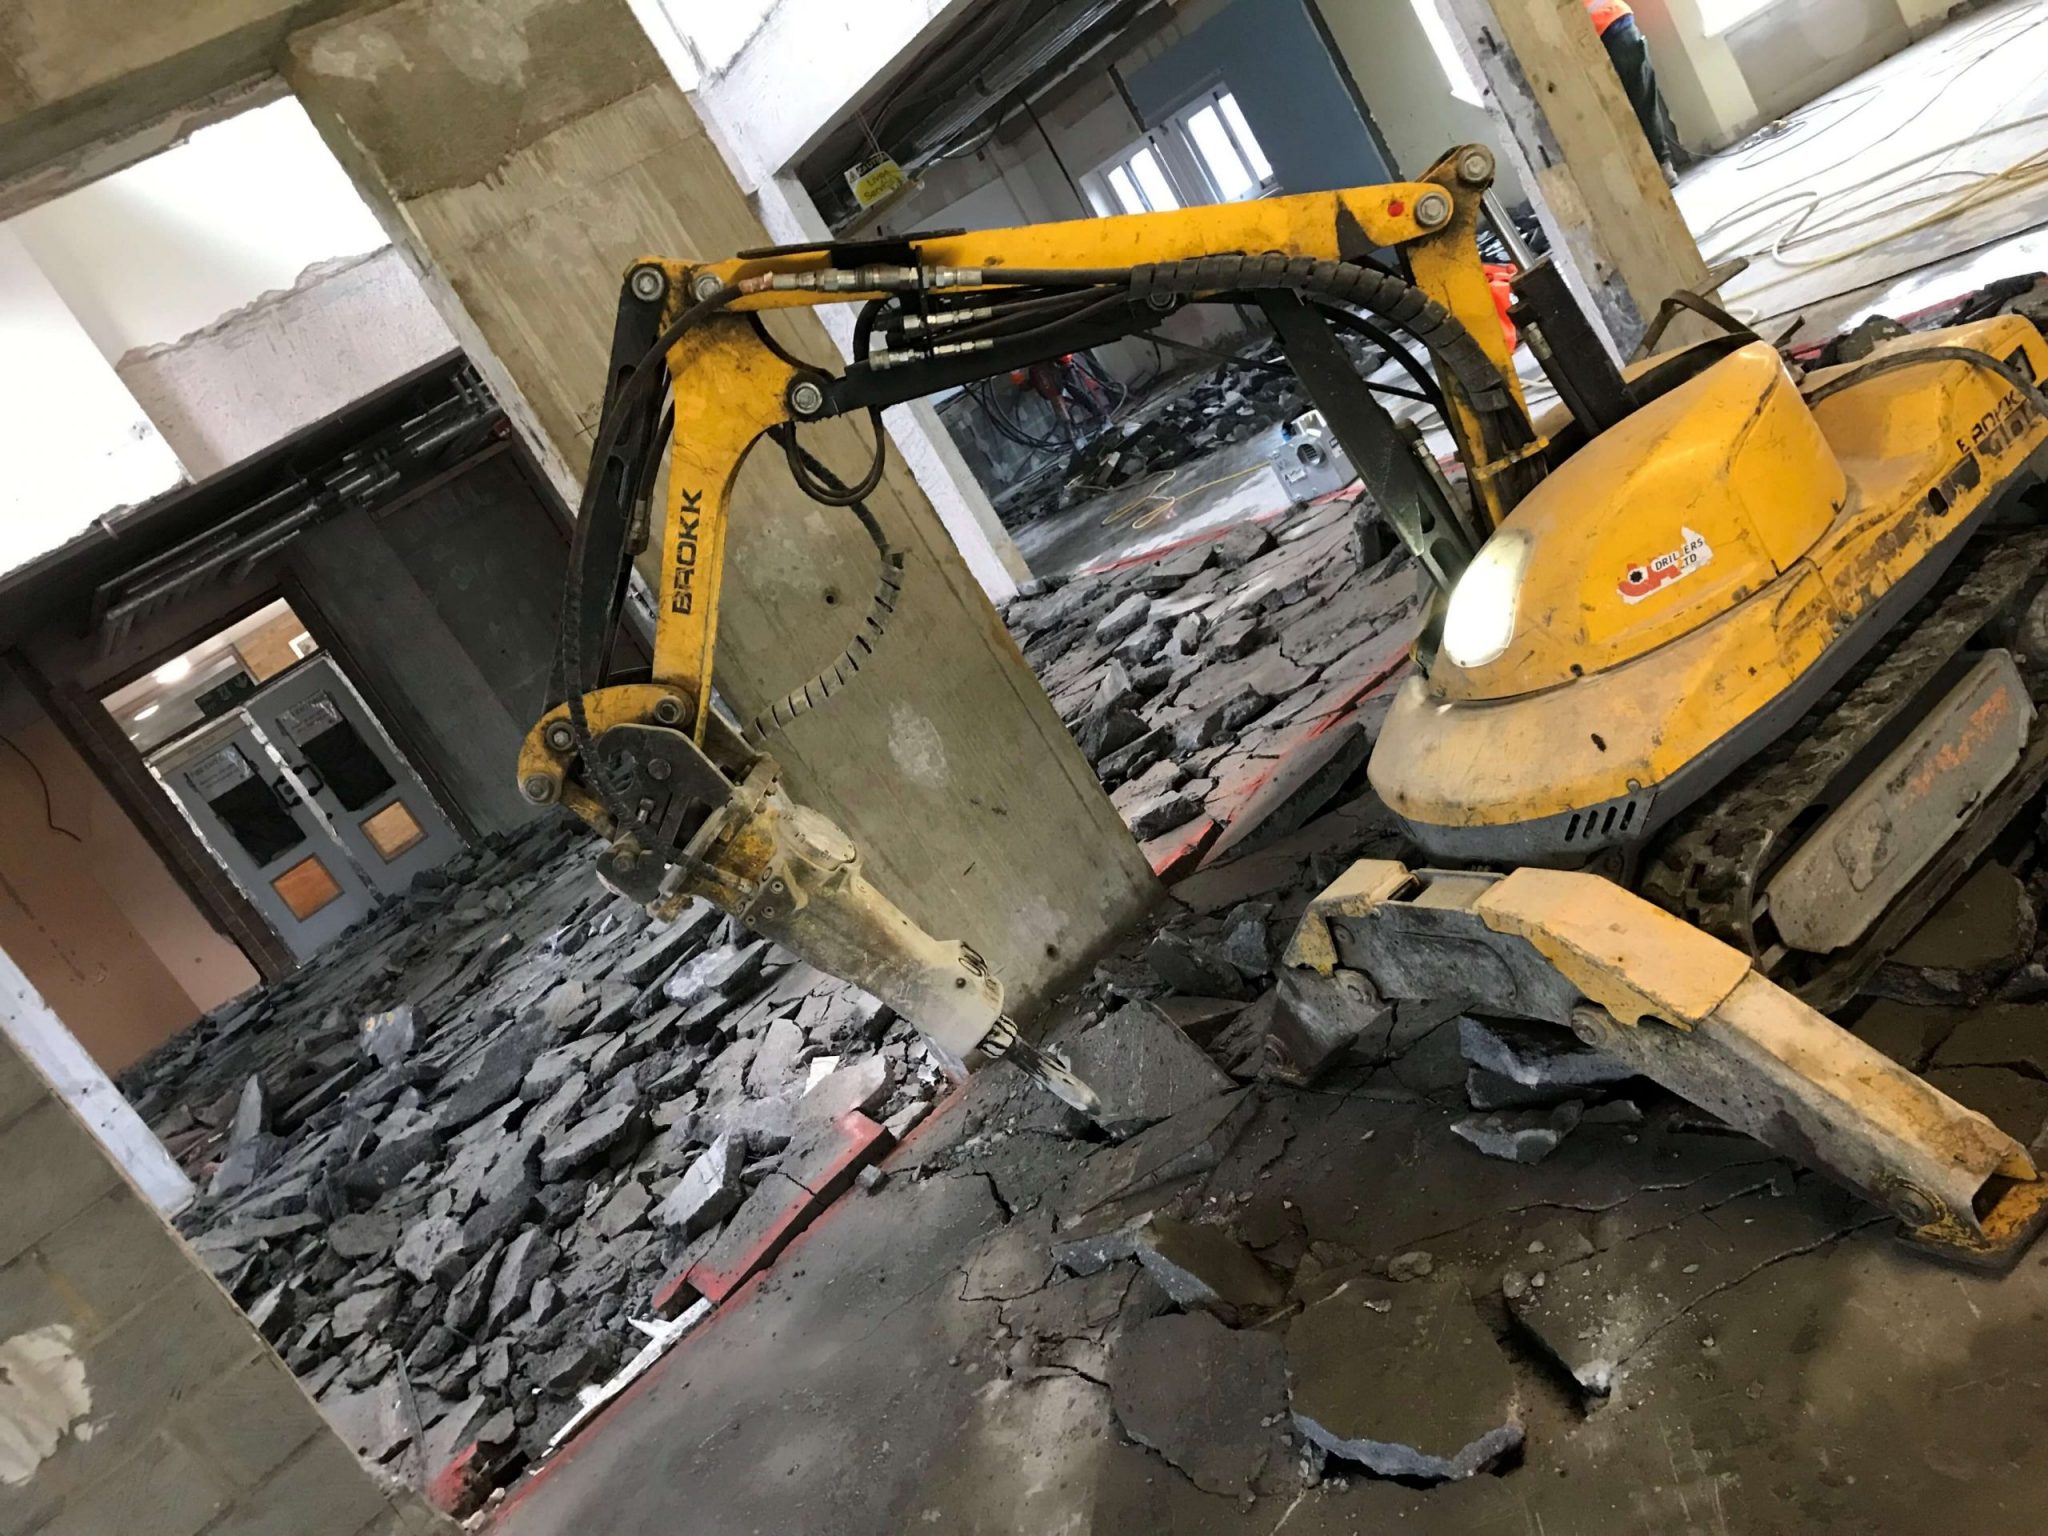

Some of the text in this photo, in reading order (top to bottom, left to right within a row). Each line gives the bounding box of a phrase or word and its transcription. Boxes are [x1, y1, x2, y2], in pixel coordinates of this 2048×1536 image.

[672, 488, 702, 614] BROKK
[1655, 538, 1704, 571] DRILERS
[1680, 553, 1697, 568] TD
